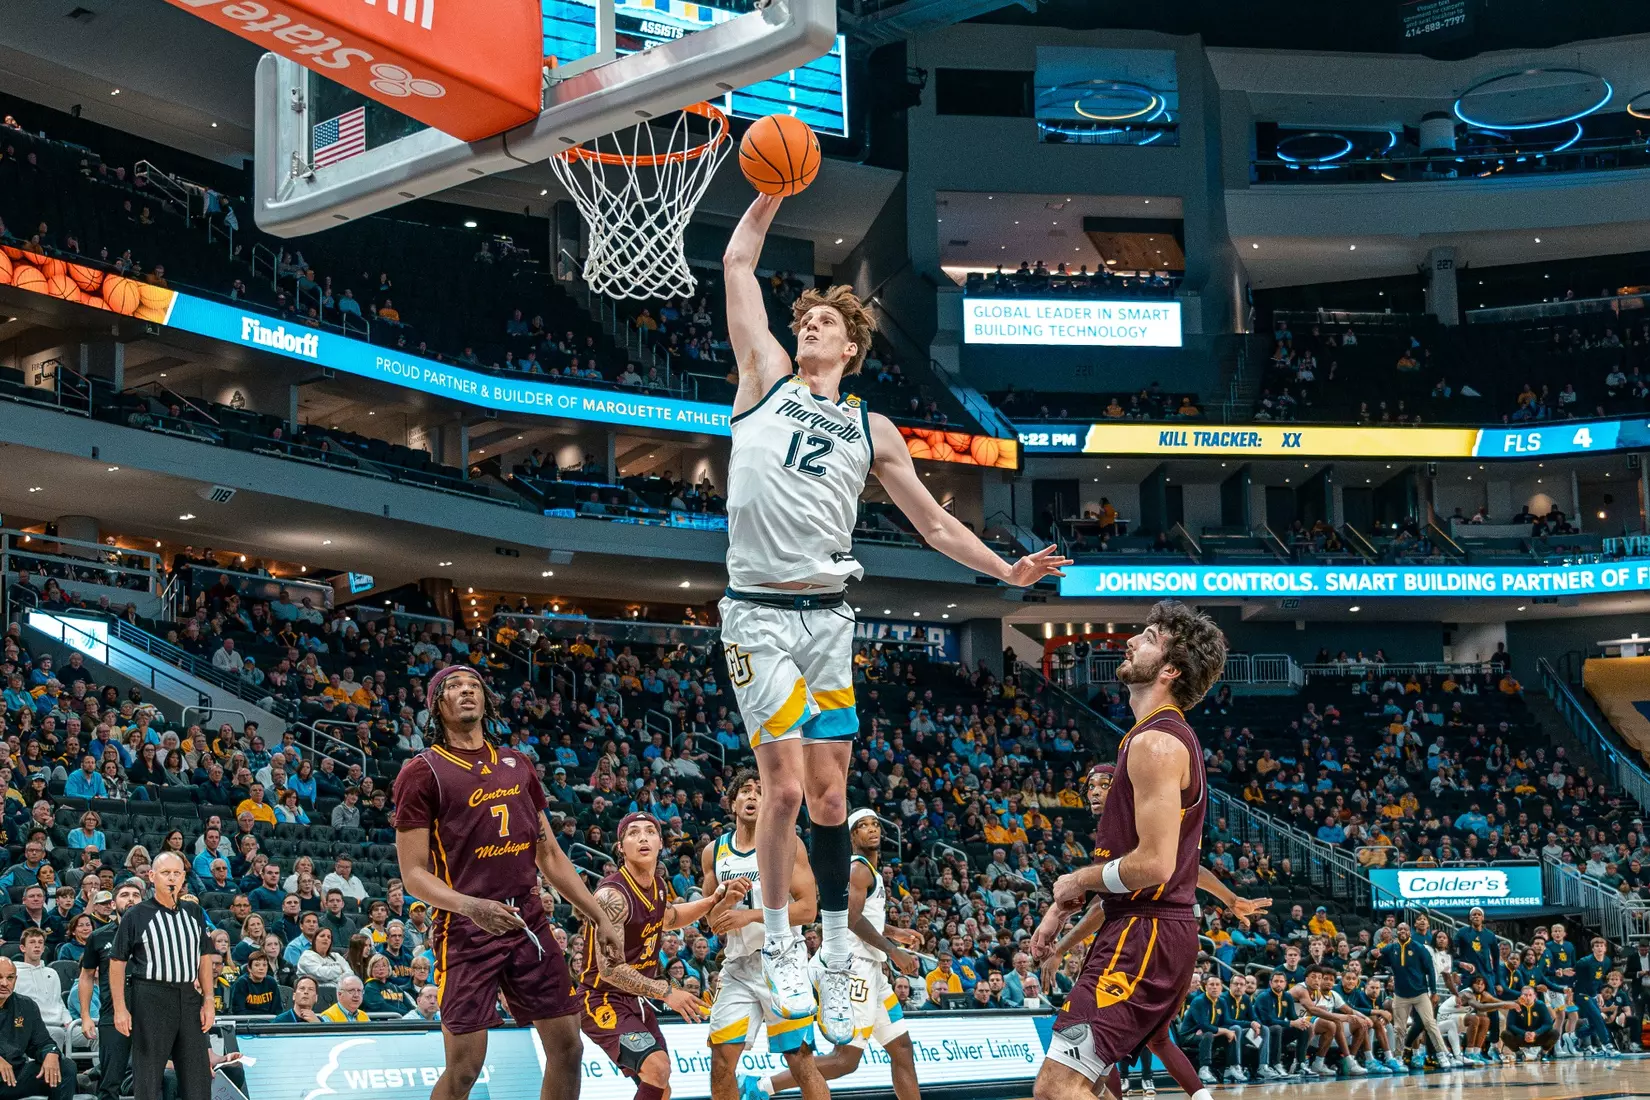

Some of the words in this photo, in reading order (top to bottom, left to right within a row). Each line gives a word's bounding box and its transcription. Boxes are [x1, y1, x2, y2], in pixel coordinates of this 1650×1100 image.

[221, 0, 374, 69] State
[640, 20, 684, 39] ASSISTS
[973, 305, 1031, 319] GLOBAL
[1037, 306, 1092, 320] LEADER
[1098, 307, 1112, 320] IN
[1118, 308, 1170, 321] SMART
[241, 316, 319, 359] Findorff
[974, 323, 1044, 337] BUILDING
[1051, 324, 1148, 338] TECHNOLOGY
[375, 356, 420, 380] PROUD
[423, 369, 478, 396] PARTNER
[481, 384, 490, 399] &
[493, 387, 554, 407] BUILDER
[557, 395, 578, 409] OF
[582, 398, 672, 421] MARQUETTE
[775, 398, 862, 444] Marquette
[1052, 433, 1077, 446] PM
[1159, 431, 1188, 447] KILL
[1193, 431, 1263, 448] TRACKER:
[1281, 432, 1303, 448] XX
[1504, 432, 1542, 453] FLS
[1572, 427, 1593, 448] 4
[783, 429, 835, 478] 12
[211, 488, 233, 503] 118
[1096, 572, 1197, 592] JOHNSON
[1203, 572, 1319, 592] CONTROLS.
[1326, 572, 1398, 592] SMART
[1404, 573, 1496, 592] BUILDING
[1502, 570, 1595, 591] PARTNER
[1601, 568, 1630, 587] OF
[468, 784, 521, 807] Central
[490, 803, 510, 838] 7
[474, 840, 531, 860] Michigan
[1409, 876, 1500, 892] Colder's
[1428, 898, 1480, 906] APPLIANCES
[1487, 897, 1540, 906] MATTRESSES
[743, 1052, 776, 1070] out
[943, 1038, 984, 1062] Silver
[986, 1037, 1036, 1063] Lining.
[343, 1068, 419, 1089] WEST
